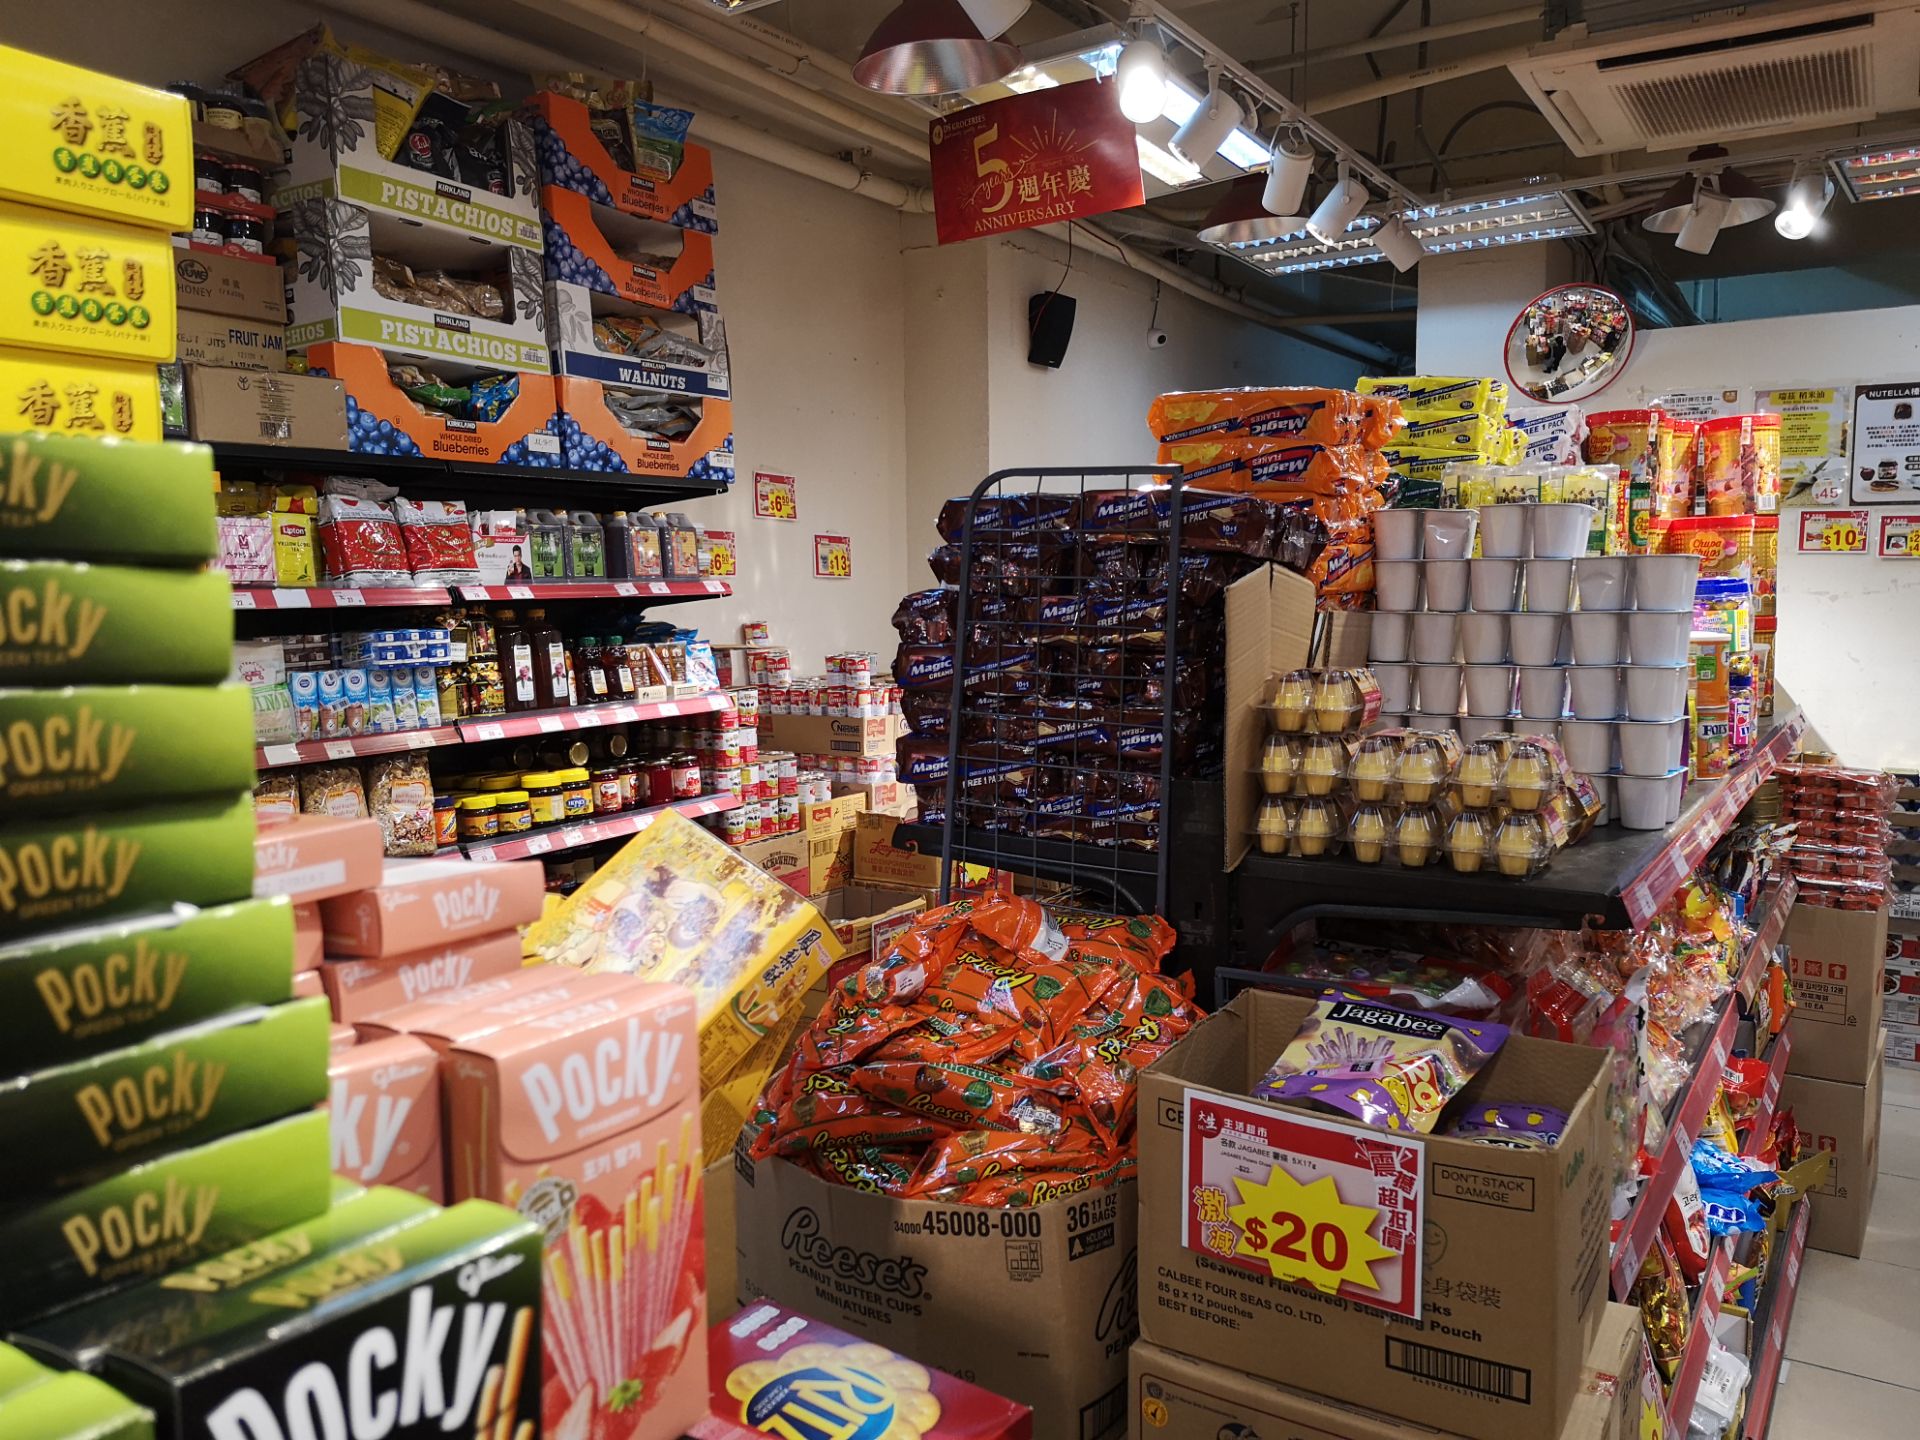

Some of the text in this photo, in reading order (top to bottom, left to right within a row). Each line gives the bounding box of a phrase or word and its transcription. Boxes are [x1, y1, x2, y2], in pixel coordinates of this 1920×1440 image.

[51, 97, 136, 158] 香蕉
[973, 123, 1014, 212] 5
[437, 183, 471, 199] KIRKLAND
[1017, 164, 1092, 204] 週年慶
[382, 182, 513, 238] PISTACHIOS
[621, 193, 665, 214] Blueberries
[974, 200, 1076, 233] ANNIVERSARY
[30, 240, 116, 296] 香蕉
[177, 283, 213, 298] HONEY
[625, 282, 668, 302] Blueberries
[435, 315, 470, 329] KIRKLAND
[228, 329, 283, 351] FRUIT JAM
[380, 319, 517, 362] PISTACHIOS
[618, 367, 686, 390] WALNUTS
[18, 379, 105, 430] 香蕉
[1438, 393, 1453, 401] PACK
[446, 420, 476, 430] KIRKLAND
[1252, 416, 1306, 433] Magic
[1548, 418, 1565, 429] PACK
[433, 440, 489, 456] Blueberries
[439, 433, 482, 443] WHOLE DRIED
[1539, 444, 1554, 453] PACK
[1590, 435, 1612, 445] Chupa
[1590, 444, 1612, 455] Chups
[637, 458, 680, 471] Blueberries
[1253, 458, 1307, 477] Magic
[1098, 498, 1148, 518] Magic
[1188, 510, 1209, 524] PACK
[282, 525, 305, 537] Lipton
[1824, 529, 1857, 546] $10
[1693, 538, 1722, 548] Chupa
[830, 555, 847, 571] $13
[1693, 548, 1721, 562] Chups
[911, 655, 952, 676] Magic
[1015, 681, 1030, 689] 10+1
[1039, 797, 1084, 814] Magic
[432, 879, 500, 930] Pocky
[35, 936, 190, 1033] Pocky
[398, 950, 474, 1002] Pocky
[1813, 1003, 1824, 1011] EA
[1332, 1002, 1444, 1034] Jagabee
[520, 1016, 684, 1145] Pocky
[74, 1048, 229, 1147] Pocky
[907, 1093, 973, 1124] Reese's
[1224, 1118, 1268, 1137] 生活超市
[813, 1130, 871, 1150] Reese's
[1238, 1143, 1271, 1158] JAGABEE
[1032, 1174, 1092, 1206] Reese's
[1442, 1169, 1526, 1193] DON'T STACK
[1091, 1193, 1118, 1211] 11 OZ
[1455, 1184, 1510, 1203] DAMAGE
[894, 1201, 1090, 1238] 34000 45008-000 36
[1091, 1206, 1118, 1224] BAGS
[62, 1174, 220, 1278] Pocky
[1245, 1210, 1349, 1272] $20
[781, 1206, 929, 1300] Reese's
[789, 1257, 923, 1317] PEANUT BUTTER CUPS
[1157, 1266, 1327, 1327] CALBEE FOUR SEAS CO. LTD.
[815, 1286, 893, 1325] MINIATURES
[1157, 1281, 1171, 1293] 85
[1192, 1291, 1204, 1305] 12
[1206, 1296, 1254, 1321] pouches
[1195, 1255, 1265, 1287] (Seaweed
[1430, 1320, 1482, 1343] Pouch
[1157, 1296, 1241, 1331] BEST BEFORE:
[206, 1284, 508, 1440] Pocky
